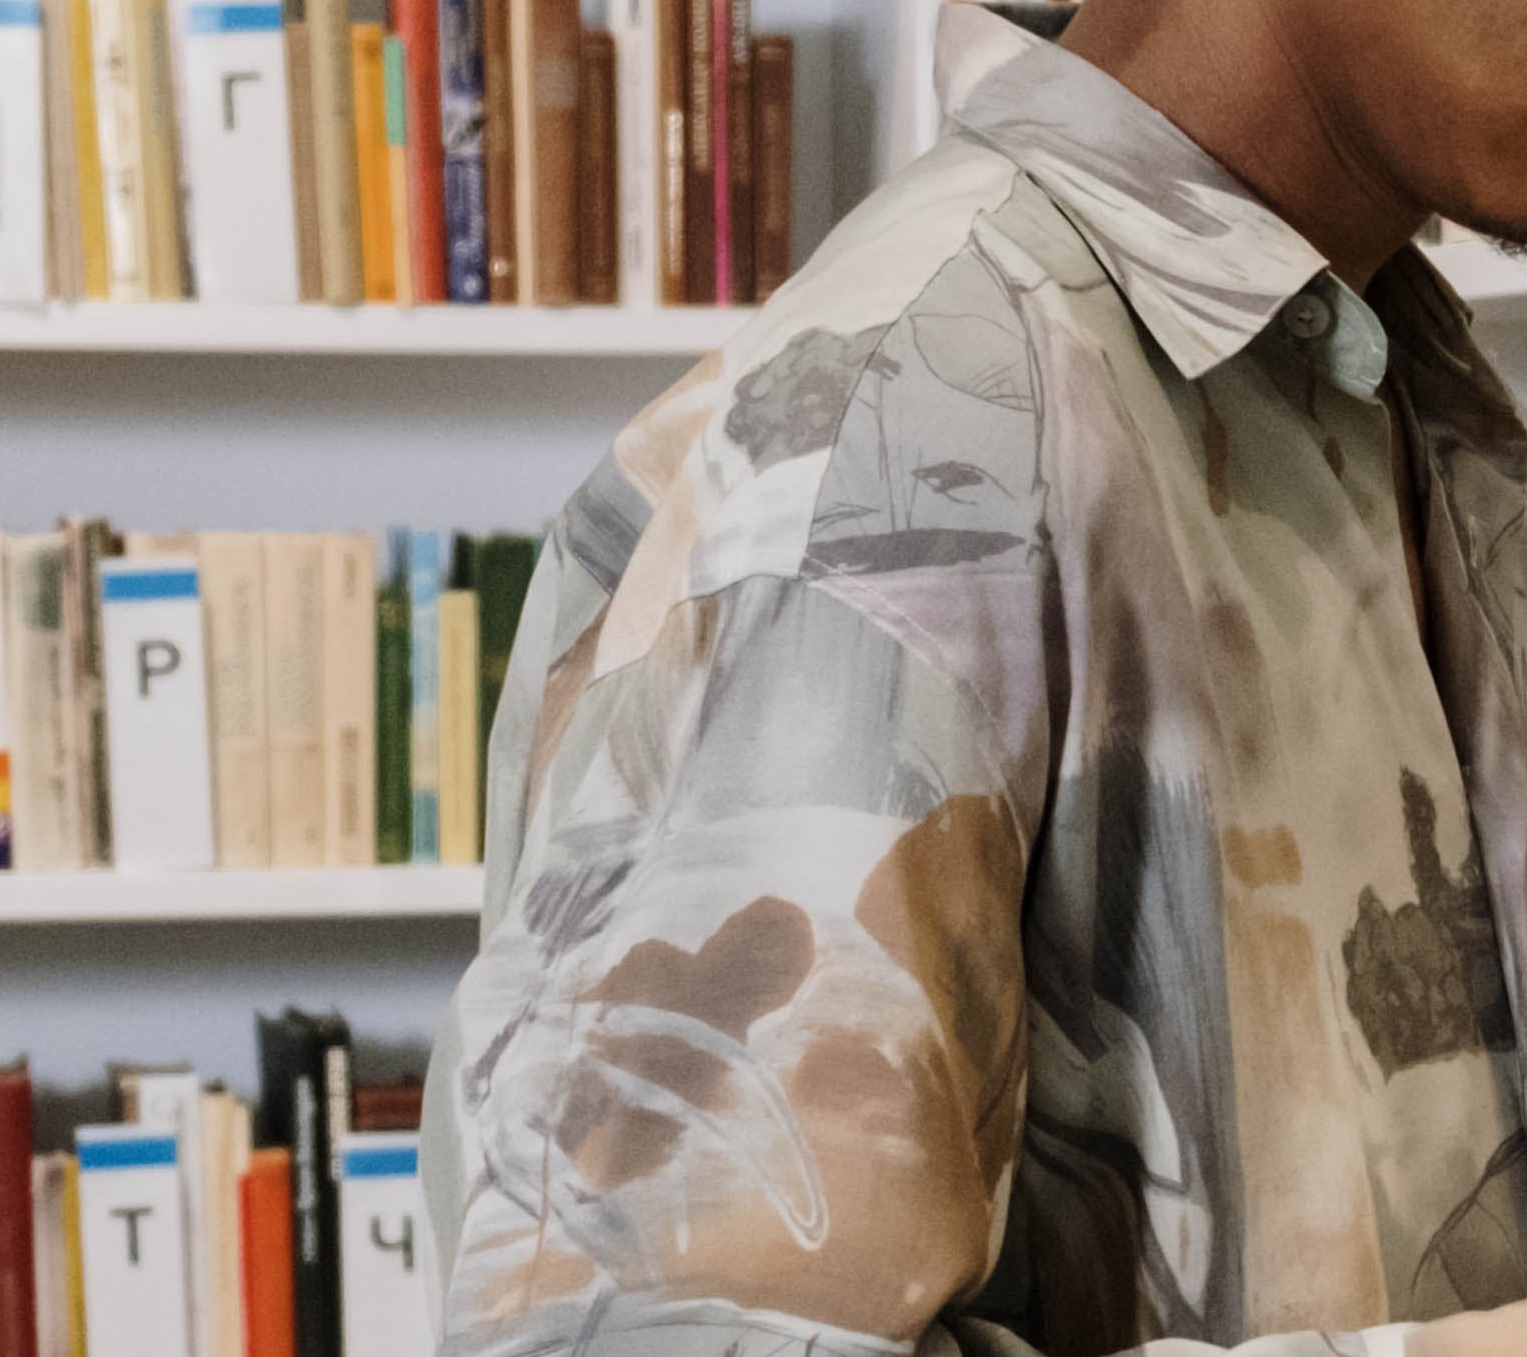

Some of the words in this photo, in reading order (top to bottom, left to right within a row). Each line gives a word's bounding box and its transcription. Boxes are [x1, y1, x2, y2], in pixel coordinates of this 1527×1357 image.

[222, 72, 263, 132] Г
[136, 641, 182, 699] Р
[109, 1208, 155, 1265] Т
[370, 1214, 416, 1271] Ч
